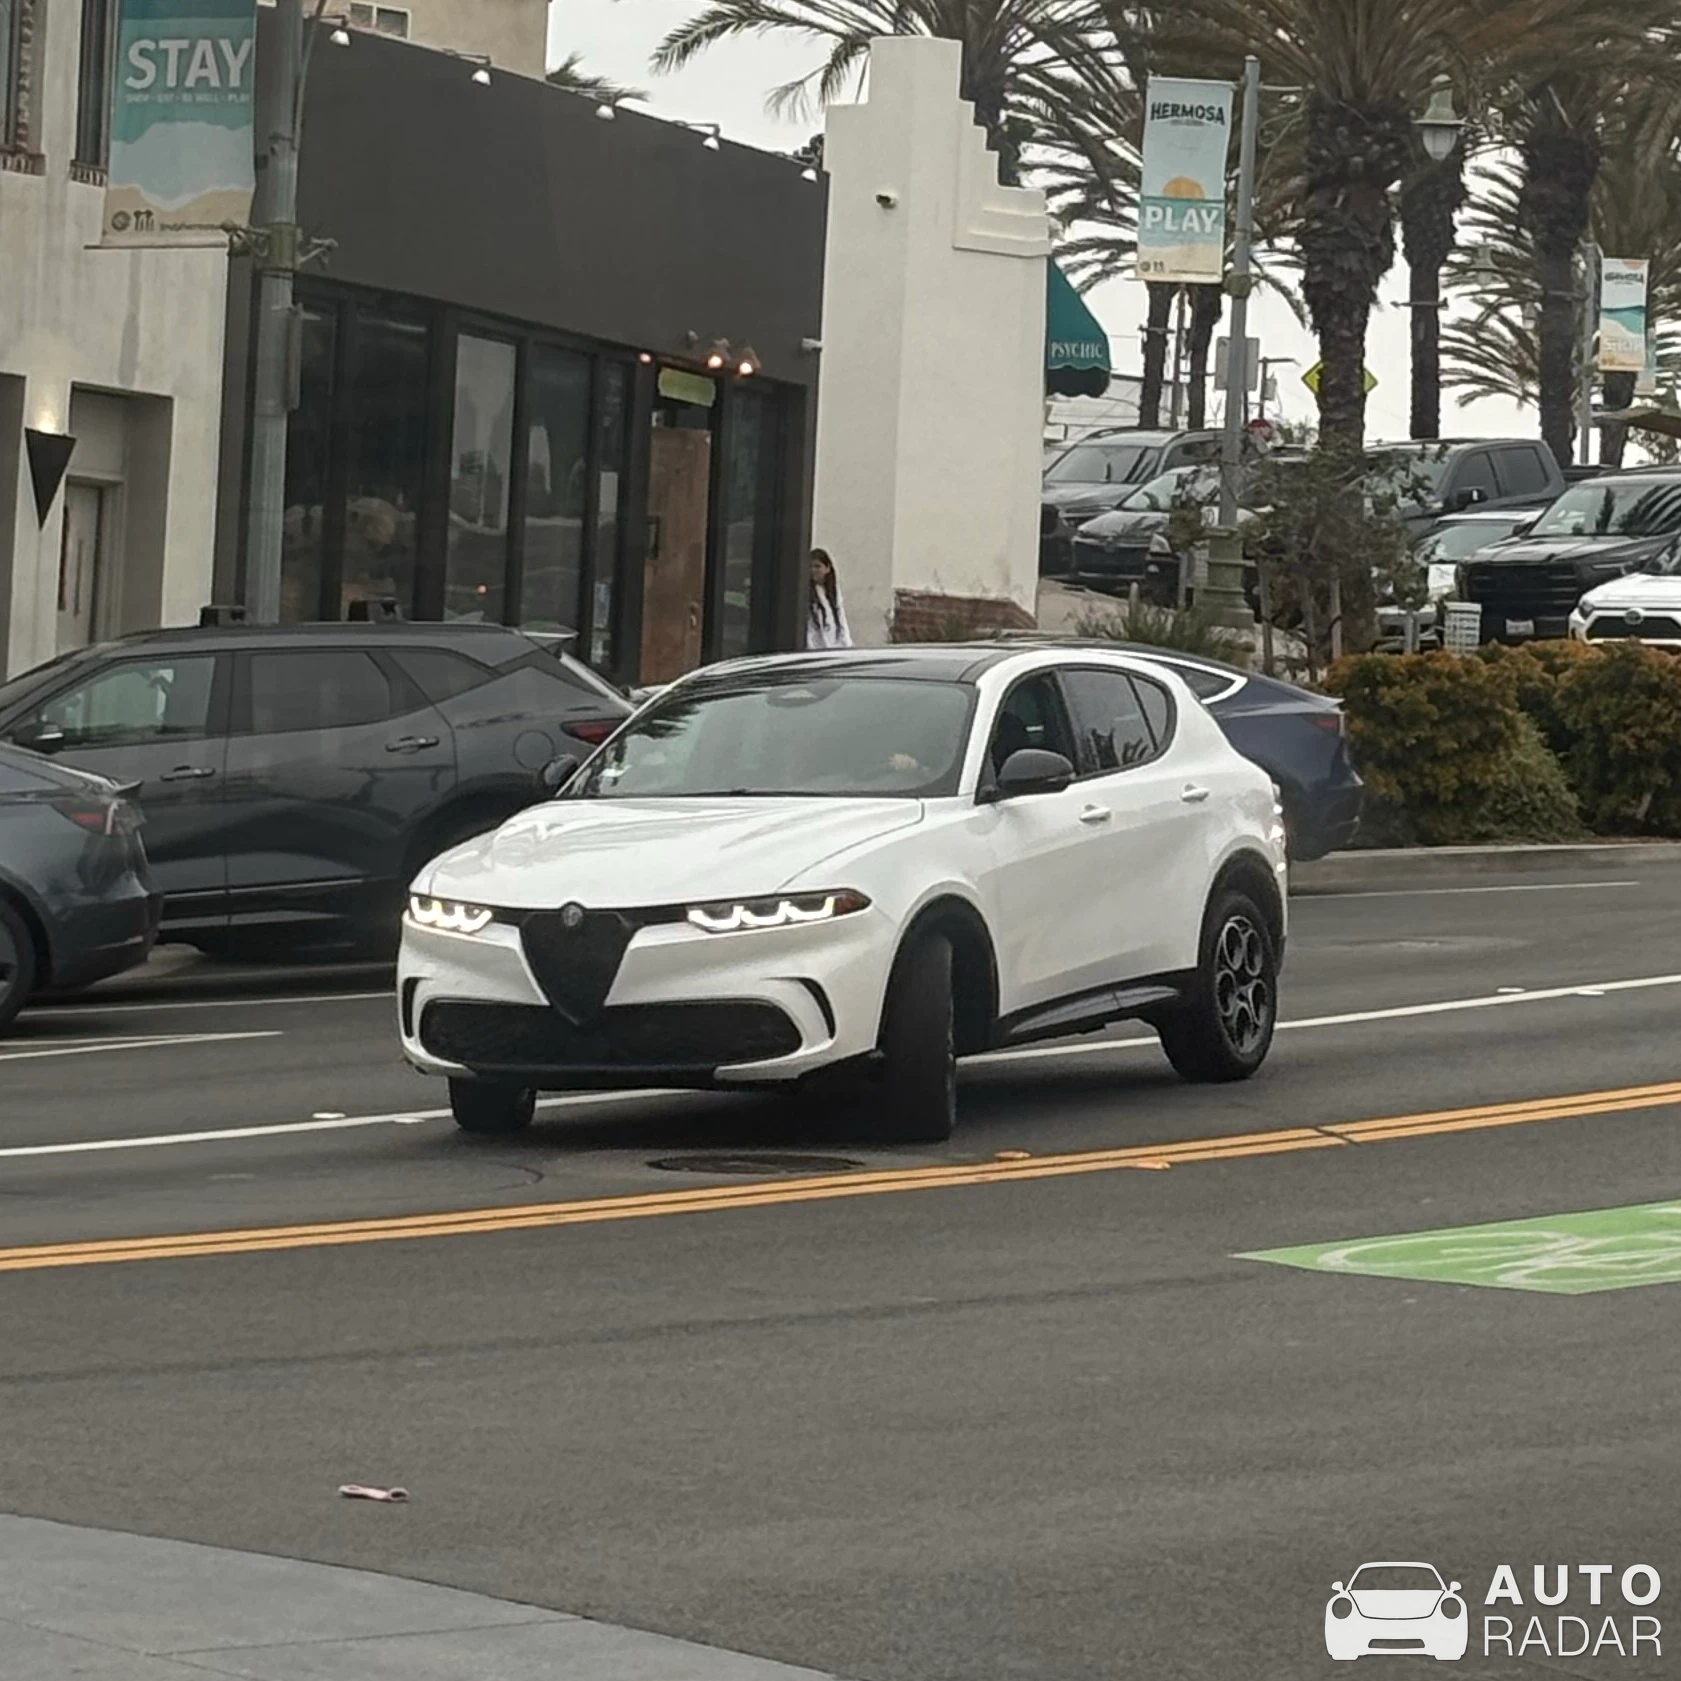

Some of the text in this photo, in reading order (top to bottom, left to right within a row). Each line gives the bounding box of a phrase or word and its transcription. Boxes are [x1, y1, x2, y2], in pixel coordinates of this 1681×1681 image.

[125, 38, 253, 90] STAY
[1150, 101, 1226, 126] HERMOSA
[1145, 205, 1220, 234] PLAY
[1051, 342, 1104, 358] PSYCHIC
